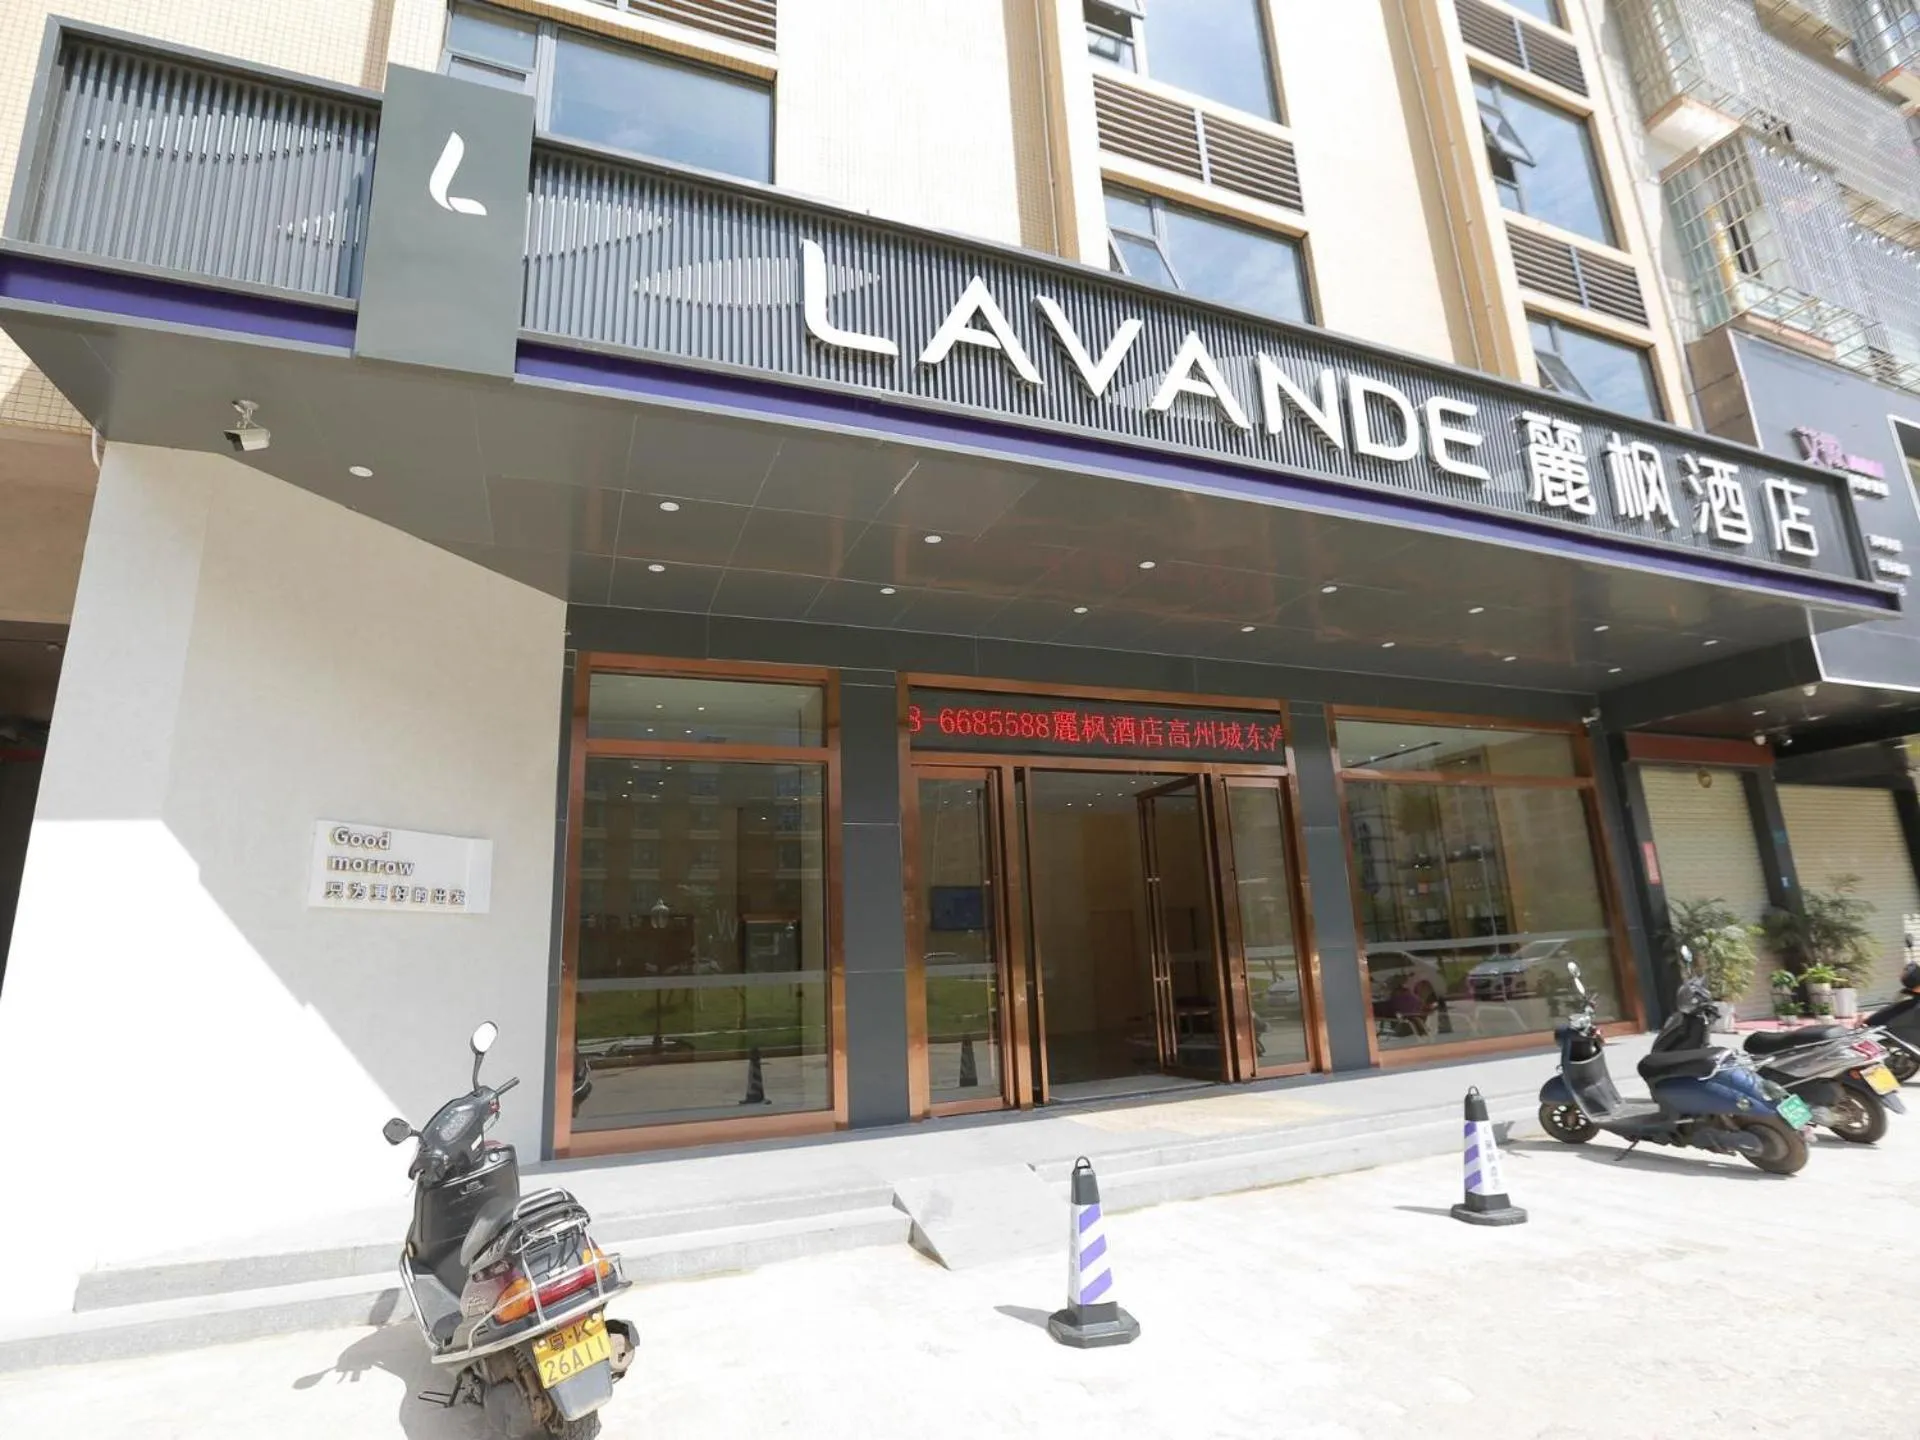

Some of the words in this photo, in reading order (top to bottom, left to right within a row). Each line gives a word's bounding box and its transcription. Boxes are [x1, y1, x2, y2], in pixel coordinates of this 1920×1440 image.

[802, 239, 1490, 482] LAVANDE
[332, 826, 391, 851] Good
[329, 855, 414, 877] morrow
